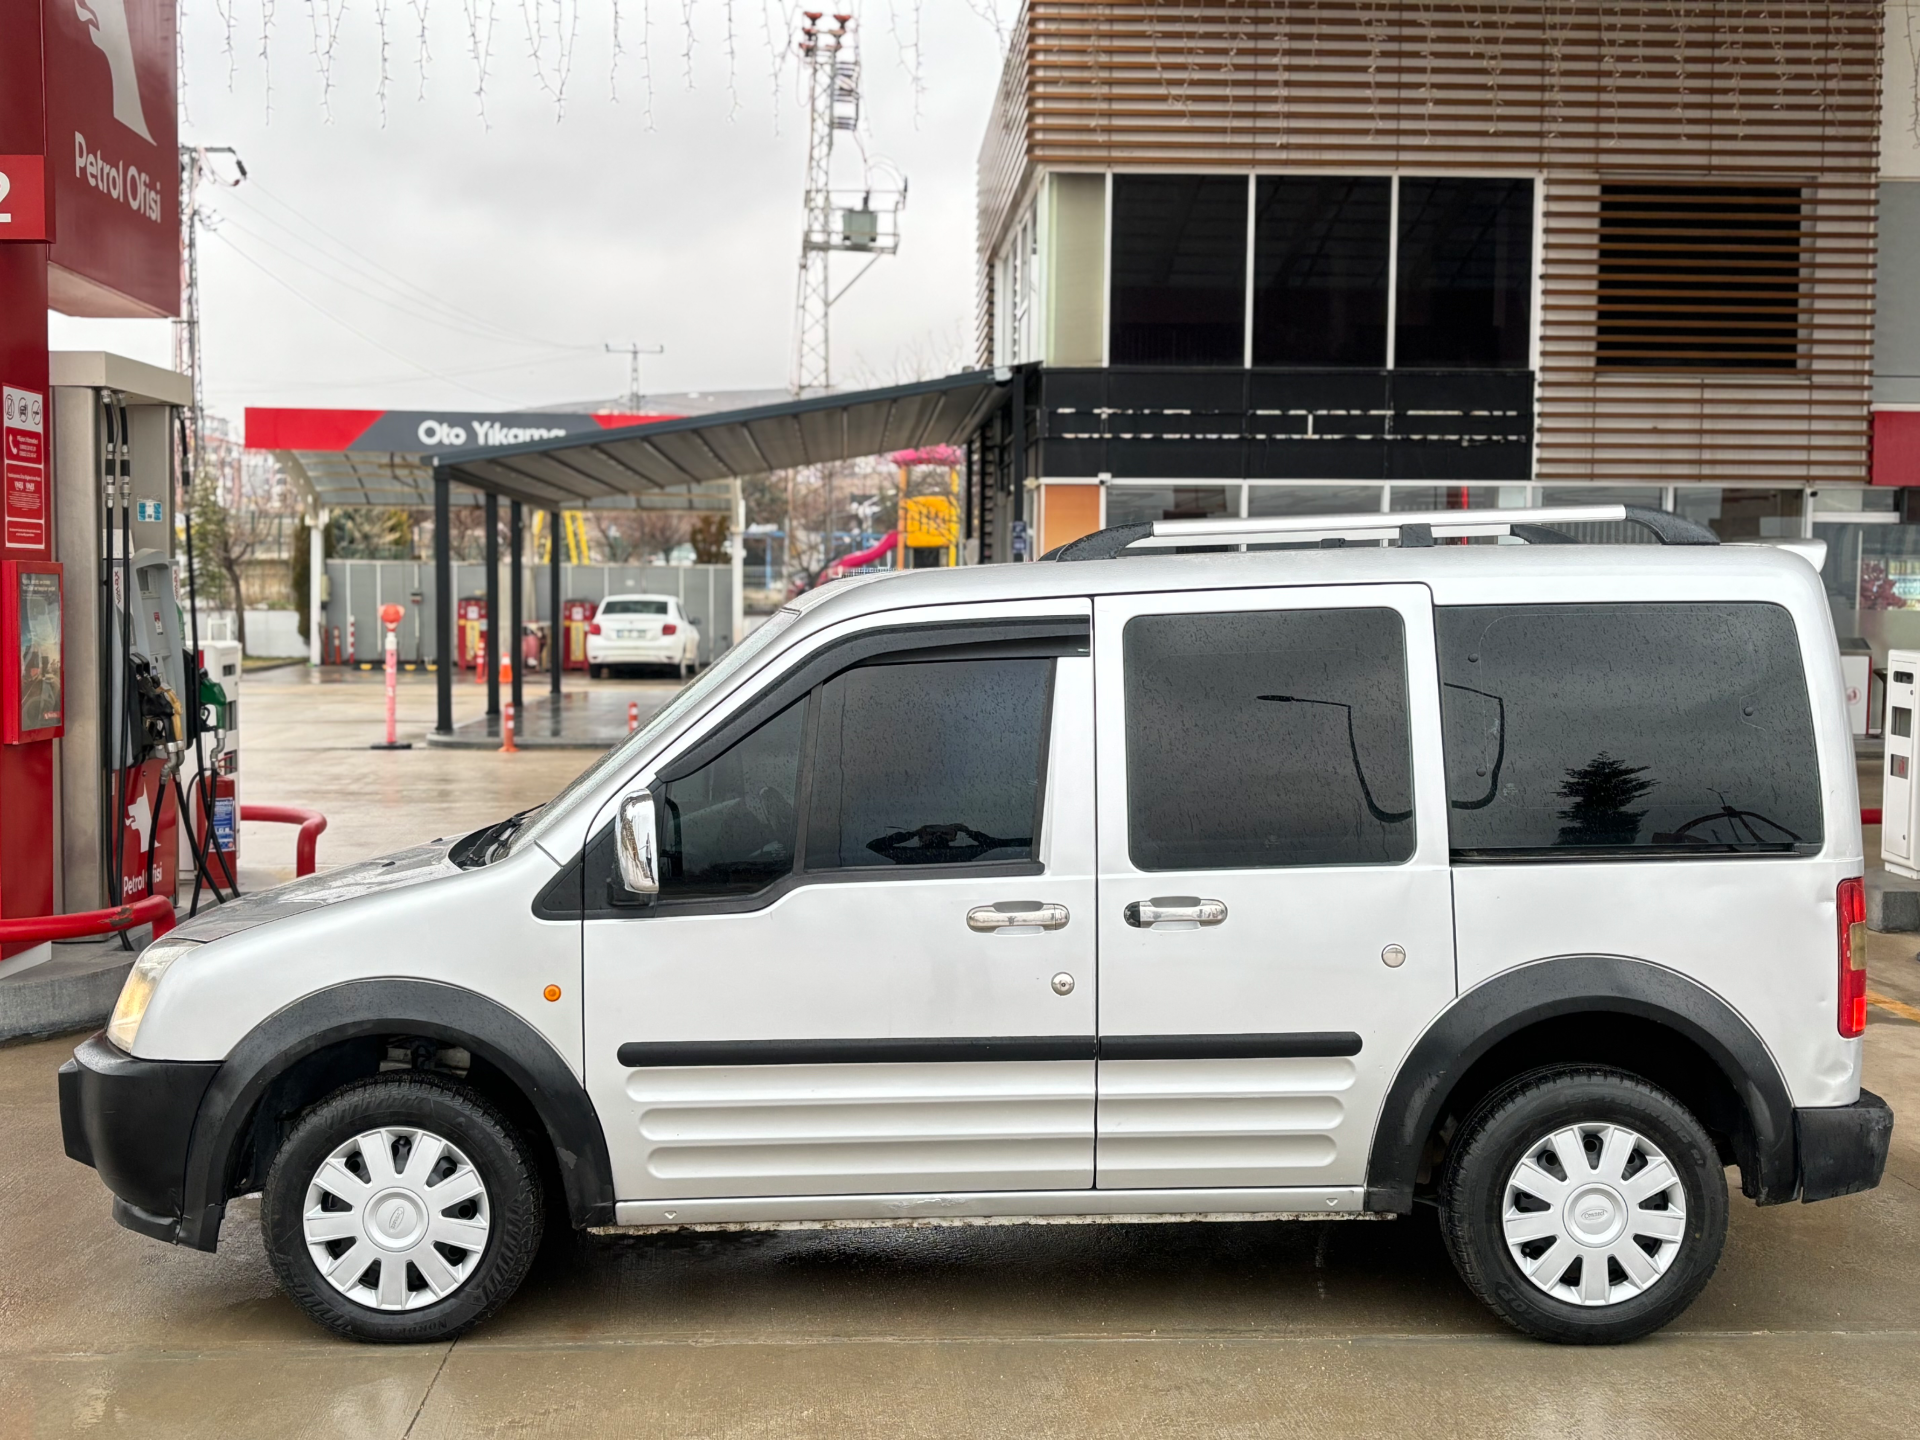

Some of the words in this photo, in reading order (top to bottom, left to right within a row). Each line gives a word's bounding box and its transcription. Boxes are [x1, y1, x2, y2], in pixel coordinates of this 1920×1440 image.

[75, 131, 123, 202] Petrol
[127, 165, 161, 223] Ofisi
[417, 419, 467, 446] Oto
[123, 869, 145, 898] Petrol
[145, 861, 163, 884] fisi
